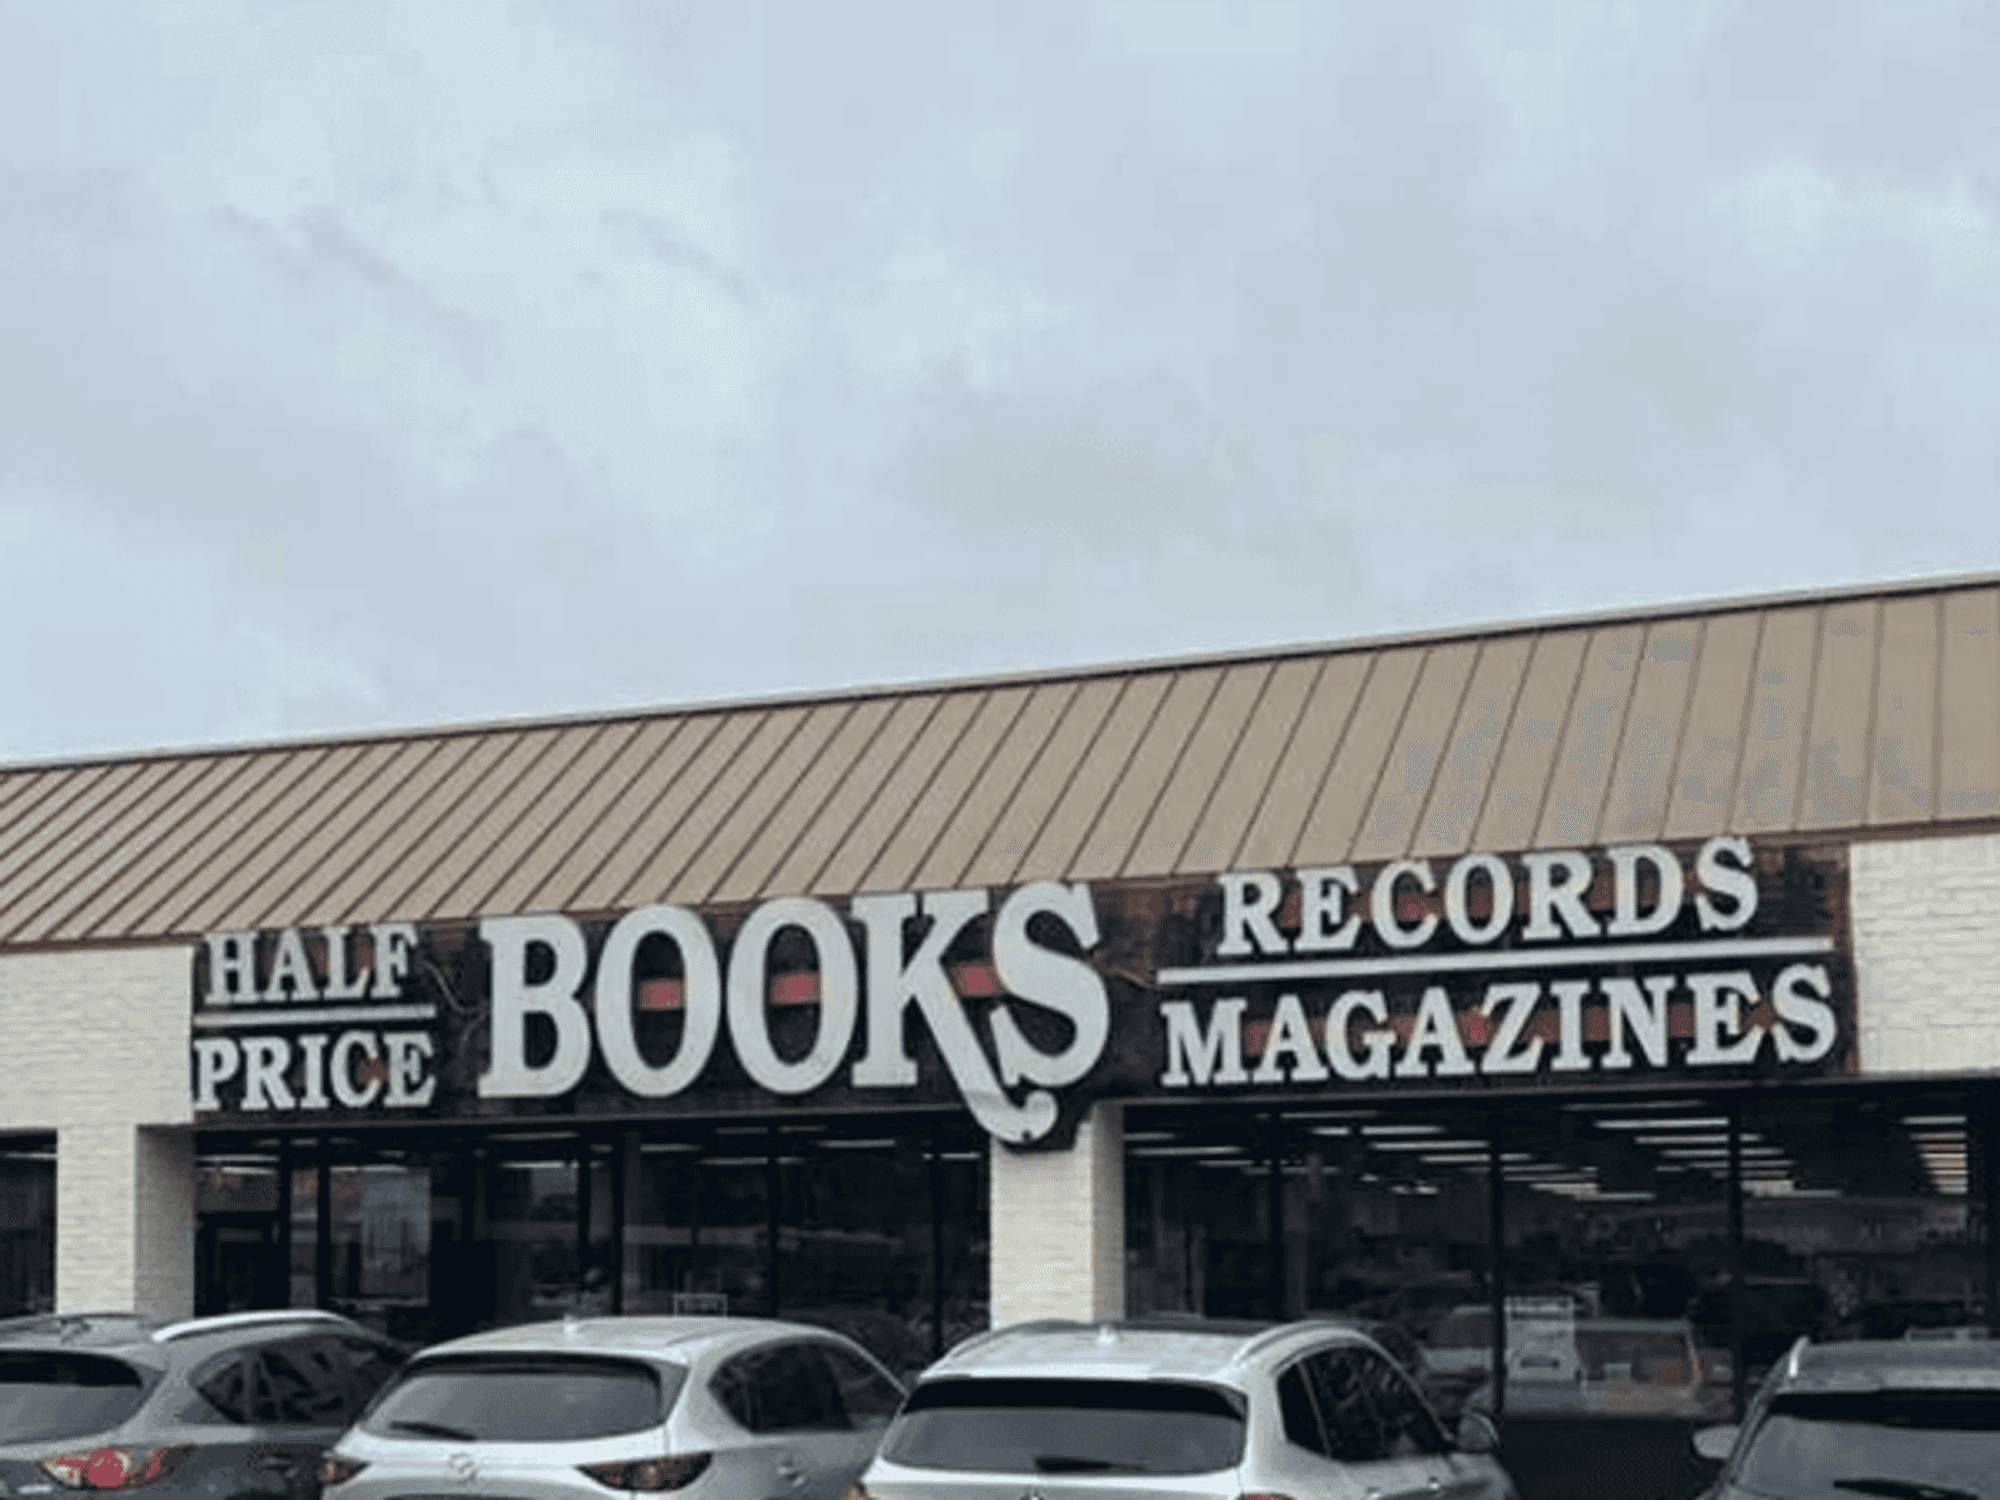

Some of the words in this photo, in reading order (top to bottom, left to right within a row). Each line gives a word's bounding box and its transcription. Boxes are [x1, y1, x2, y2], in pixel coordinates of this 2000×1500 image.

[1216, 837, 1759, 956] RECORDS
[203, 923, 418, 1004] HALF
[478, 881, 1110, 1143] BOOKS
[193, 1030, 437, 1111] PRICE
[1160, 964, 1837, 1087] MAGAZINES
